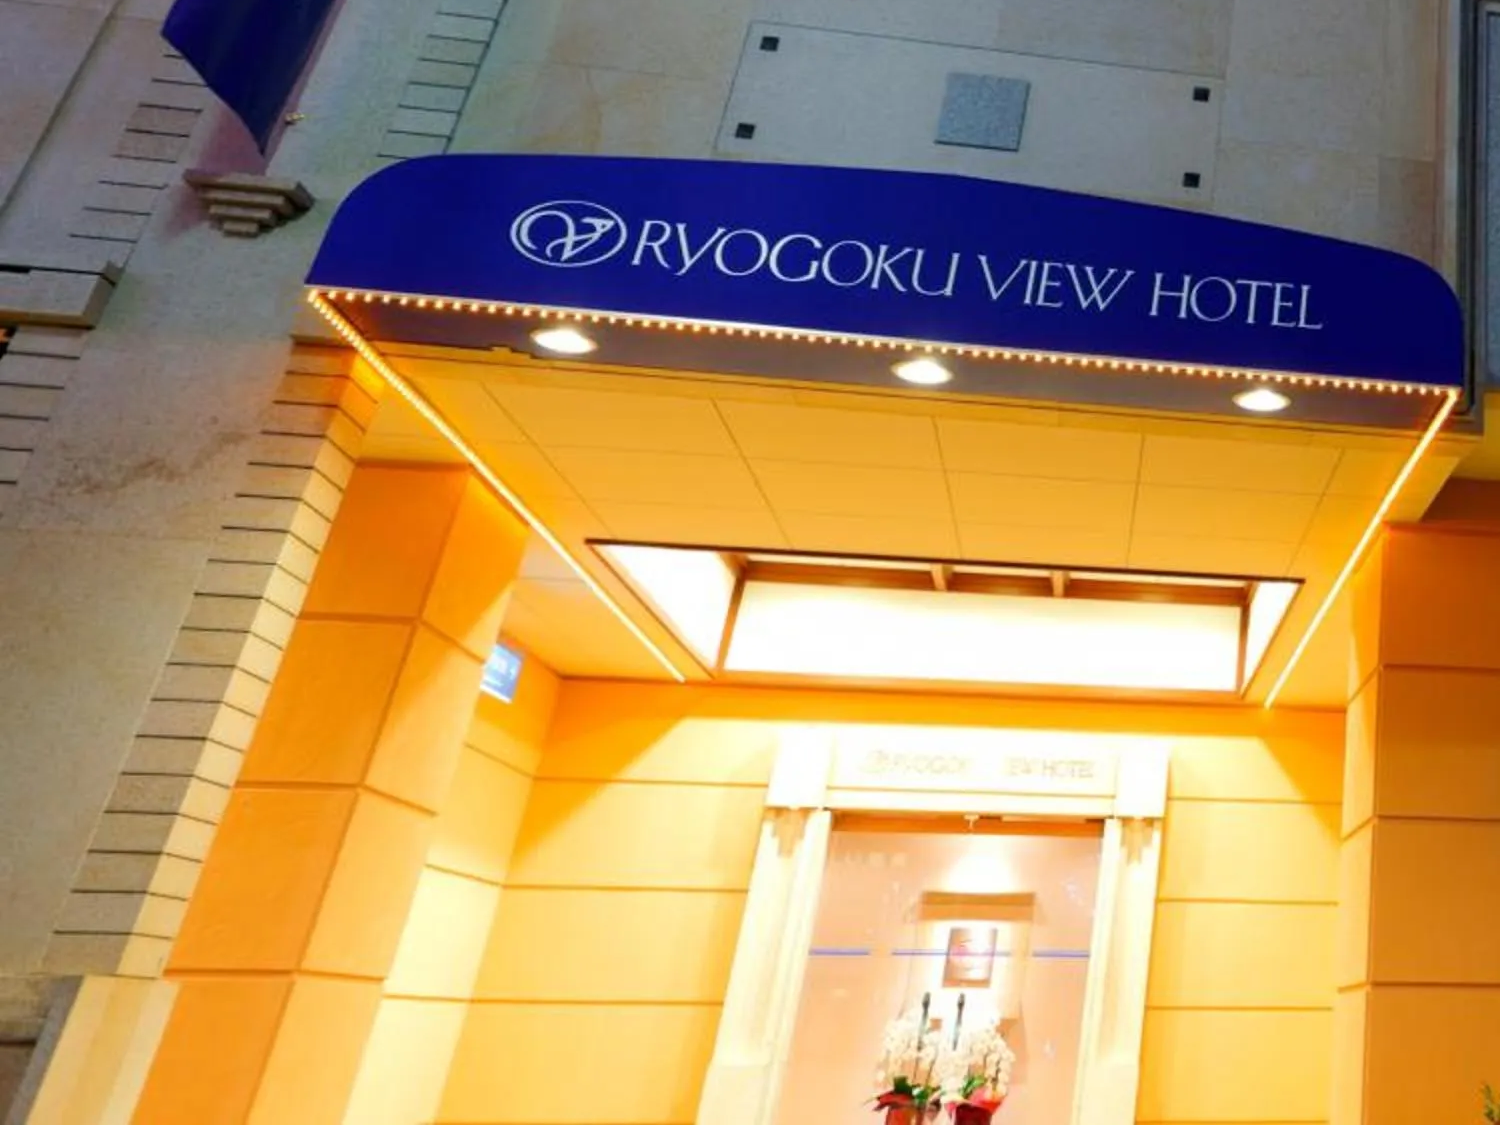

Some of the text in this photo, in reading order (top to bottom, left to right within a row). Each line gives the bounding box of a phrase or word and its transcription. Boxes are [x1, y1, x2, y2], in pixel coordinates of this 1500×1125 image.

[631, 219, 1323, 332] RYOGOKU VIEW HOTEL
